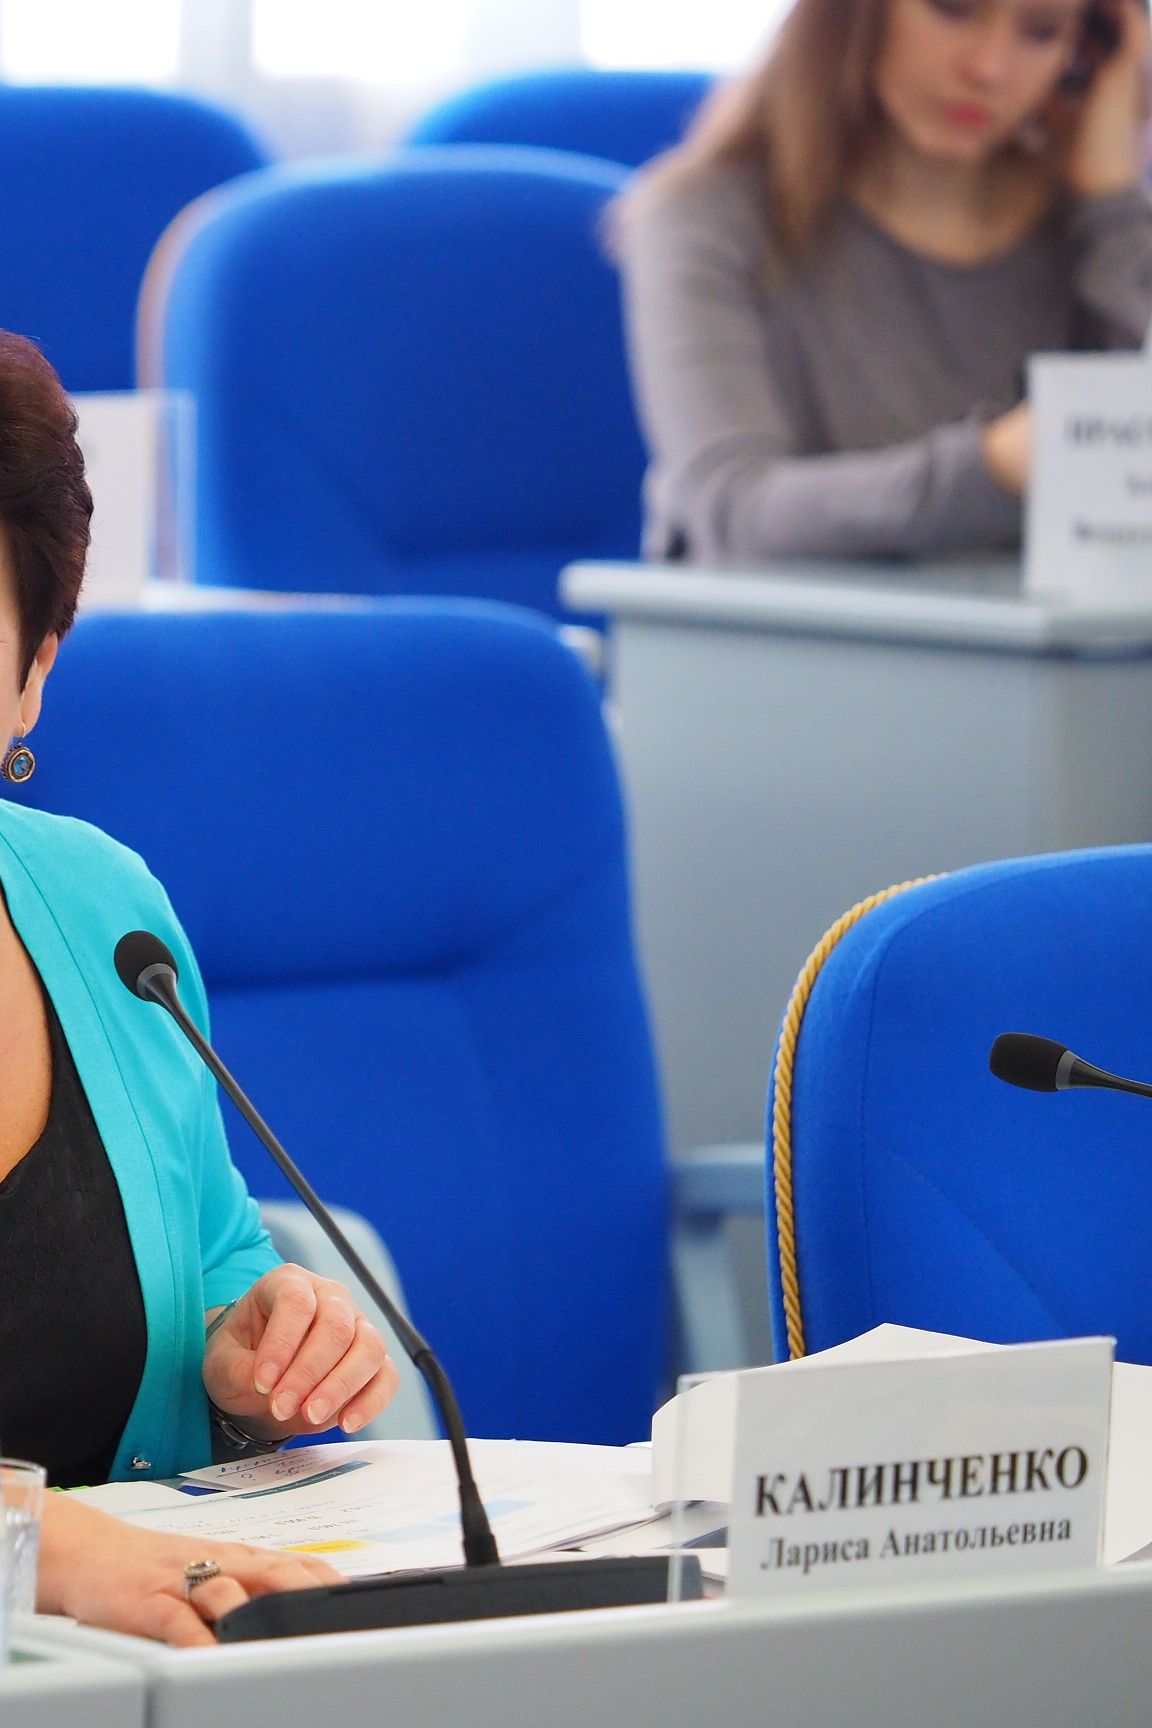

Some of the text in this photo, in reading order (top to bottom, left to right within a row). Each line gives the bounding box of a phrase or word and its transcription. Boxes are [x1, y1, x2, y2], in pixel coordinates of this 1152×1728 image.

[754, 1445, 1090, 1518] КАЛИНЧЕНКО
[760, 1518, 1073, 1575] Лариса Анатольевна
